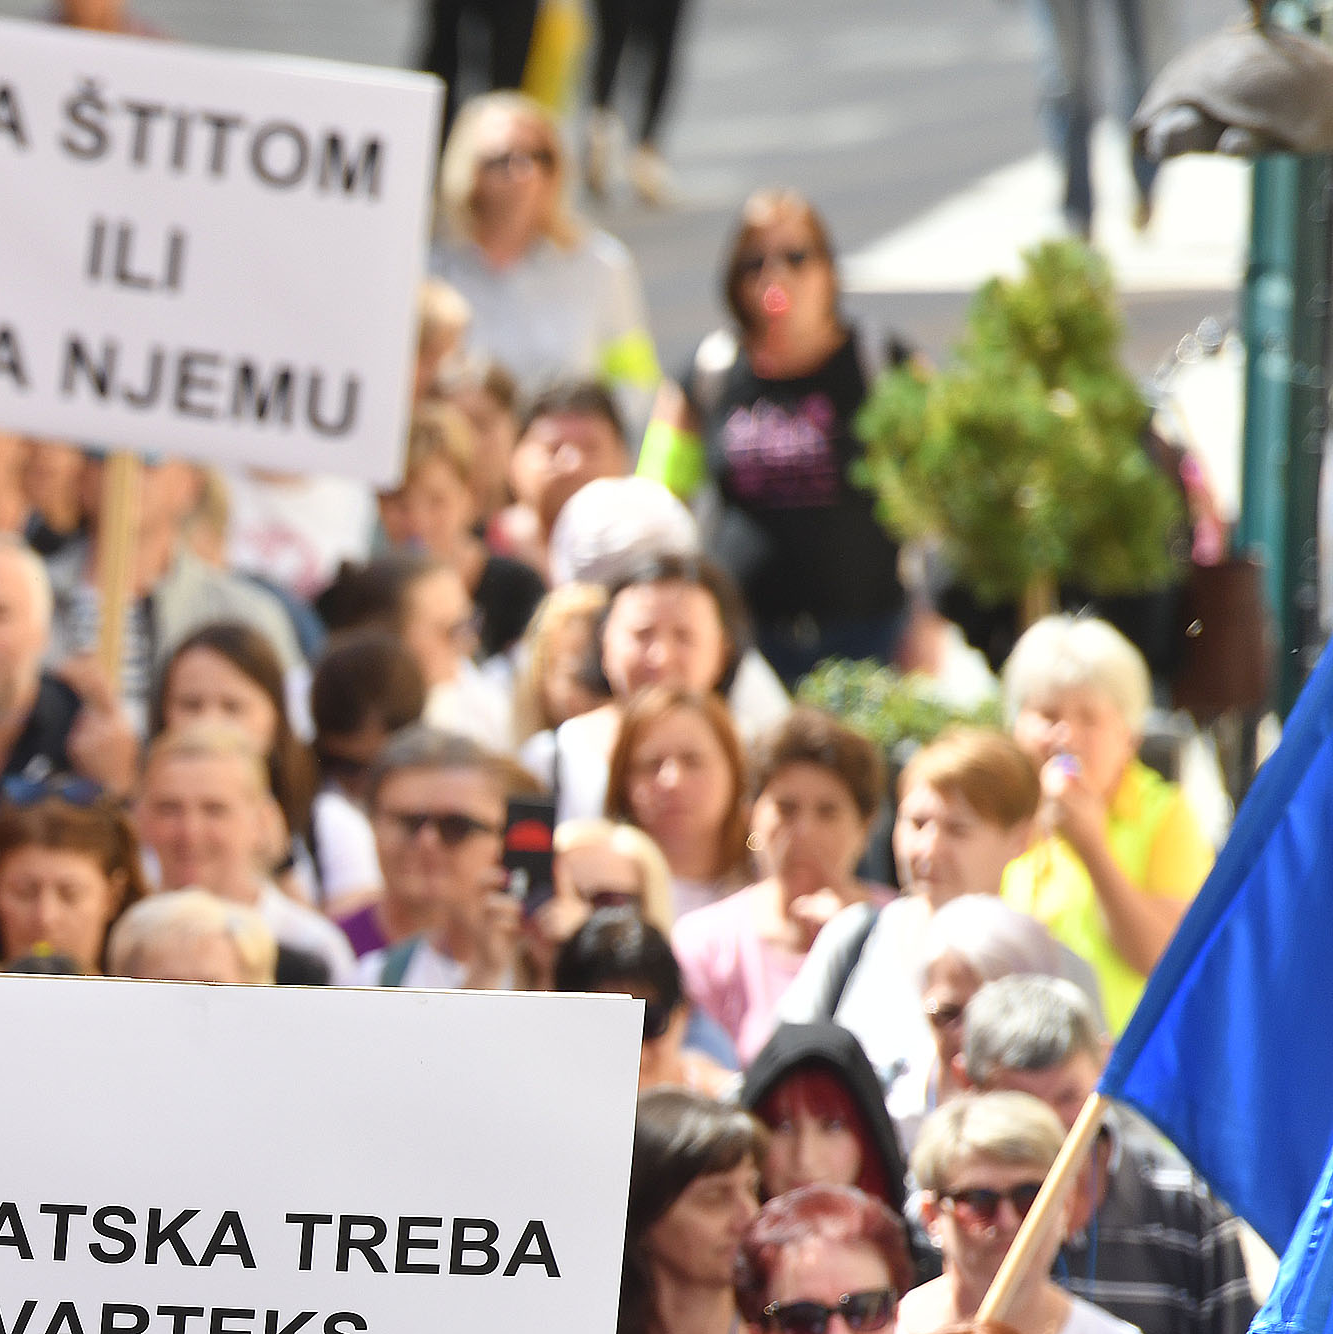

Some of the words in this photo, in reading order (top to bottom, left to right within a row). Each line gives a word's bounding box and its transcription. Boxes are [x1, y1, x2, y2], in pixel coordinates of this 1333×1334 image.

[61, 75, 385, 200] ŠTITOM
[87, 216, 186, 293] ILI
[60, 331, 361, 438] NJEMU
[284, 1211, 563, 1278] TREBA
